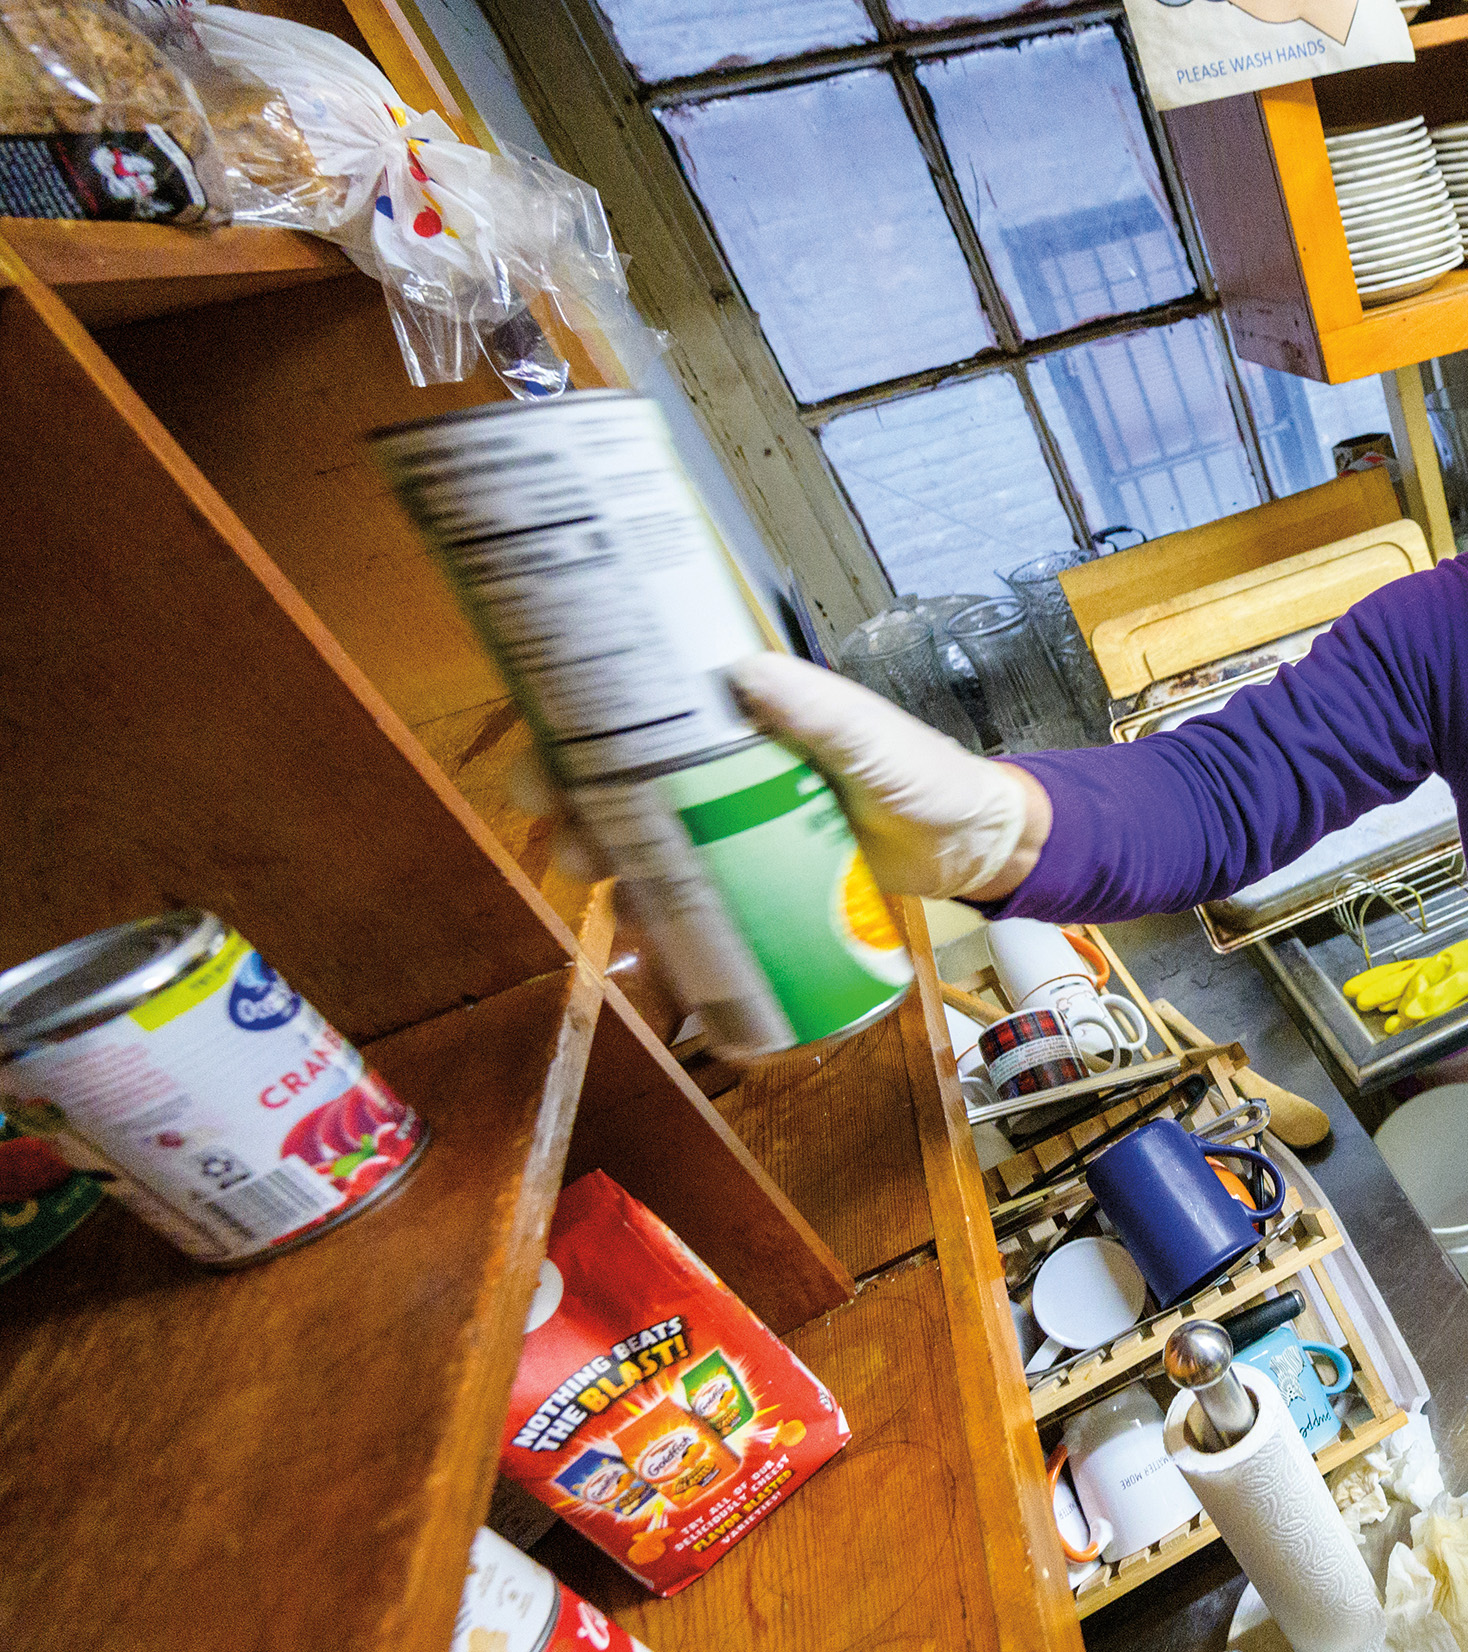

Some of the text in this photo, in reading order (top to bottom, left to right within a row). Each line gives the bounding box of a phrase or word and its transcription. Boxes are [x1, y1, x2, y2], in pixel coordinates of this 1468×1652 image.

[1176, 38, 1326, 85] PLEASE WASH HANDS
[511, 1315, 683, 1449] NOTHING BEATS
[531, 1333, 690, 1453] THE BLAST!
[647, 1435, 693, 1477] Goldfish
[1119, 1471, 1143, 1491] MORE
[673, 1492, 747, 1552] DELICIOUSLY
[750, 1453, 790, 1493] CHEESY
[680, 1459, 775, 1535] TRY ALL OF OUR
[692, 1512, 743, 1553] FLAVOR
[742, 1469, 794, 1512] BLASTED
[720, 1490, 782, 1544] VARIETIES!
